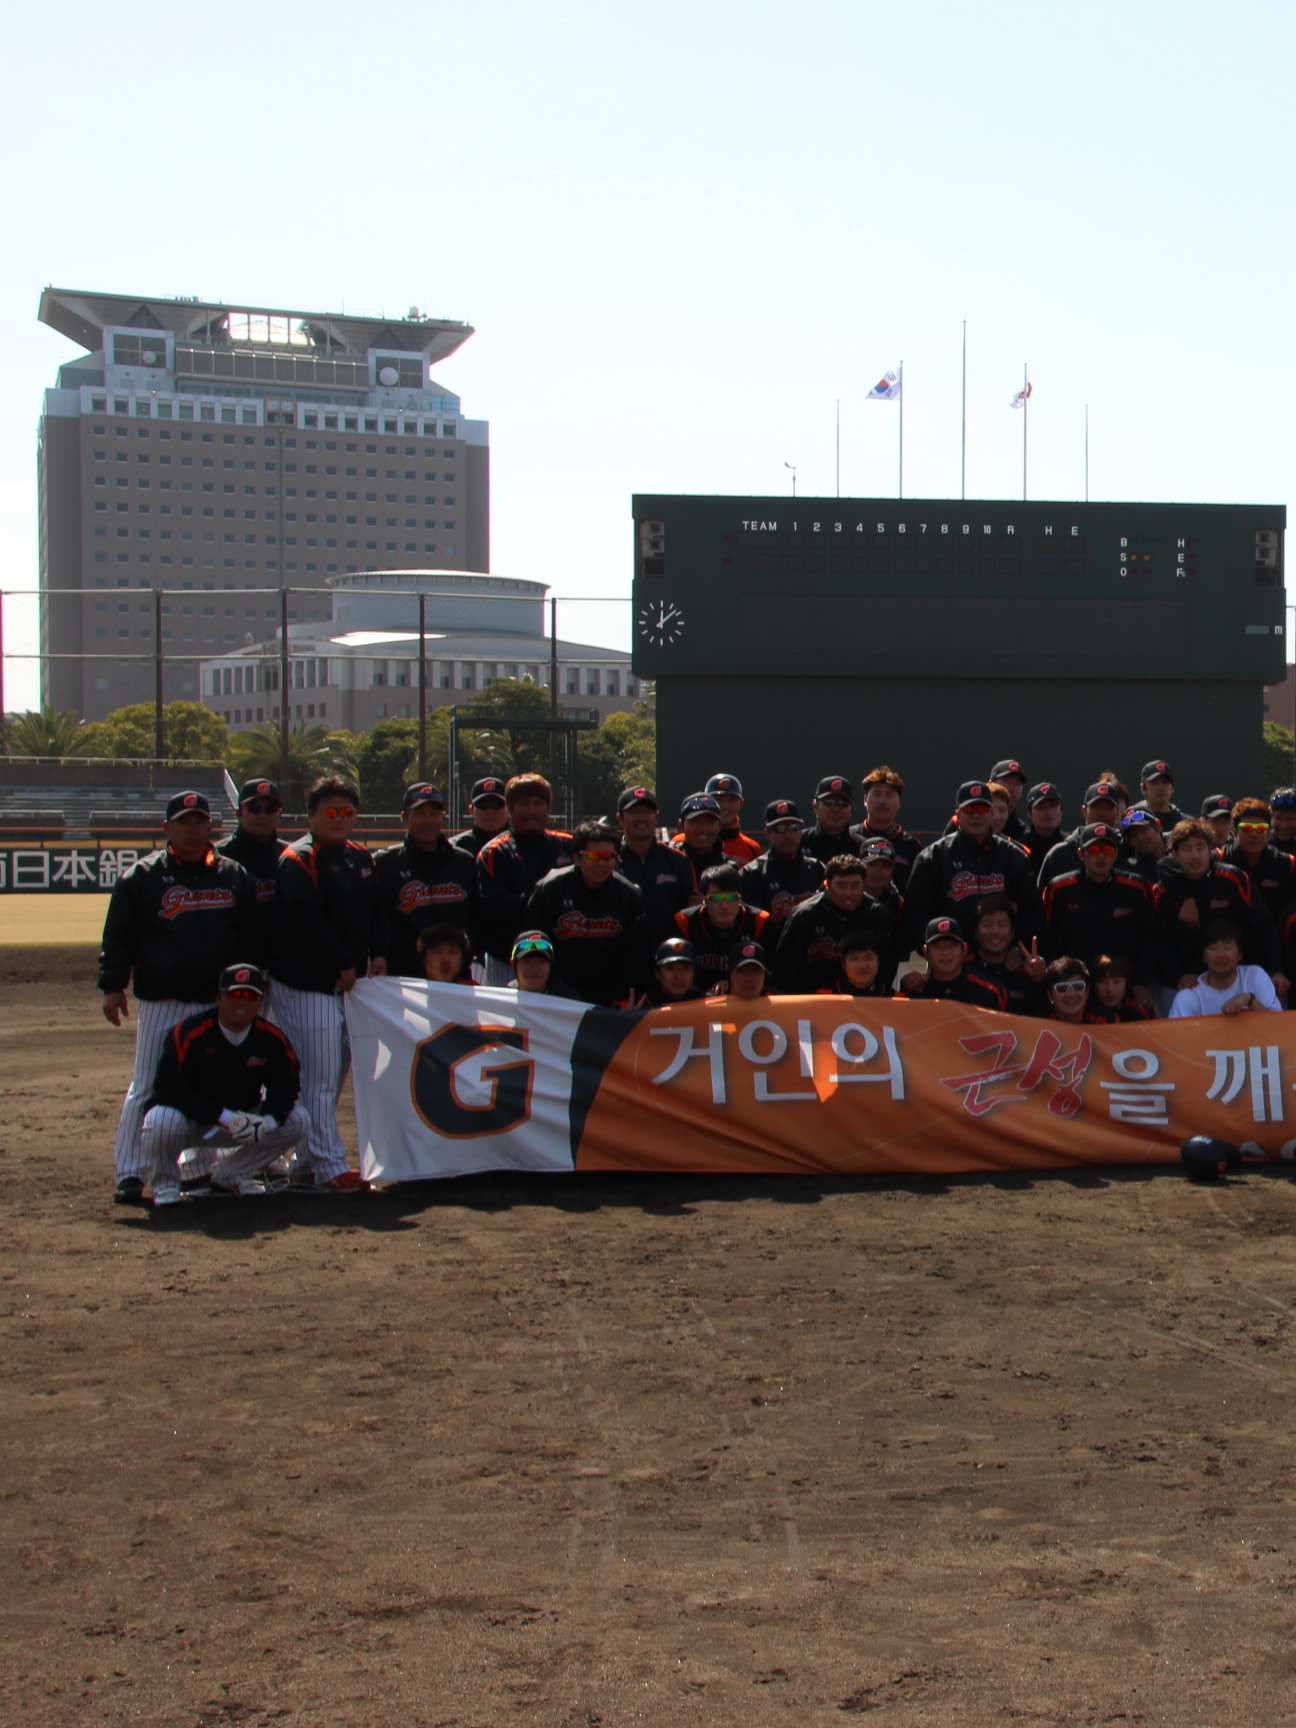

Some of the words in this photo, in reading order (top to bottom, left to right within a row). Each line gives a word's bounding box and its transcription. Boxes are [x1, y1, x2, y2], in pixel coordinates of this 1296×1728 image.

[742, 521, 777, 531] TEAM
[793, 522, 797, 531] 1
[813, 522, 820, 532] 2
[834, 523, 842, 532] 3
[856, 523, 863, 532] 4
[877, 523, 884, 533] 5
[898, 524, 906, 533] 6
[920, 524, 927, 534] 7
[941, 524, 948, 534] 8
[962, 525, 970, 534] 9
[983, 525, 992, 534] 10
[1007, 526, 1015, 535] R
[1045, 526, 1053, 536] H
[1071, 527, 1079, 536] E
[1120, 537, 1128, 547] B
[1177, 538, 1185, 548] H
[1120, 552, 1127, 562] S
[1177, 553, 1185, 563] E
[1274, 625, 1283, 635] m
[0, 850, 138, 887] 日本銀
[395, 879, 467, 914] Giants
[947, 870, 1006, 902] Giants
[158, 885, 236, 920] Giants
[553, 910, 623, 940] Giants
[234, 969, 250, 983] G
[410, 1022, 535, 1139] G
[650, 1019, 905, 1104] 거인의
[940, 1029, 1175, 1125] 근성을
